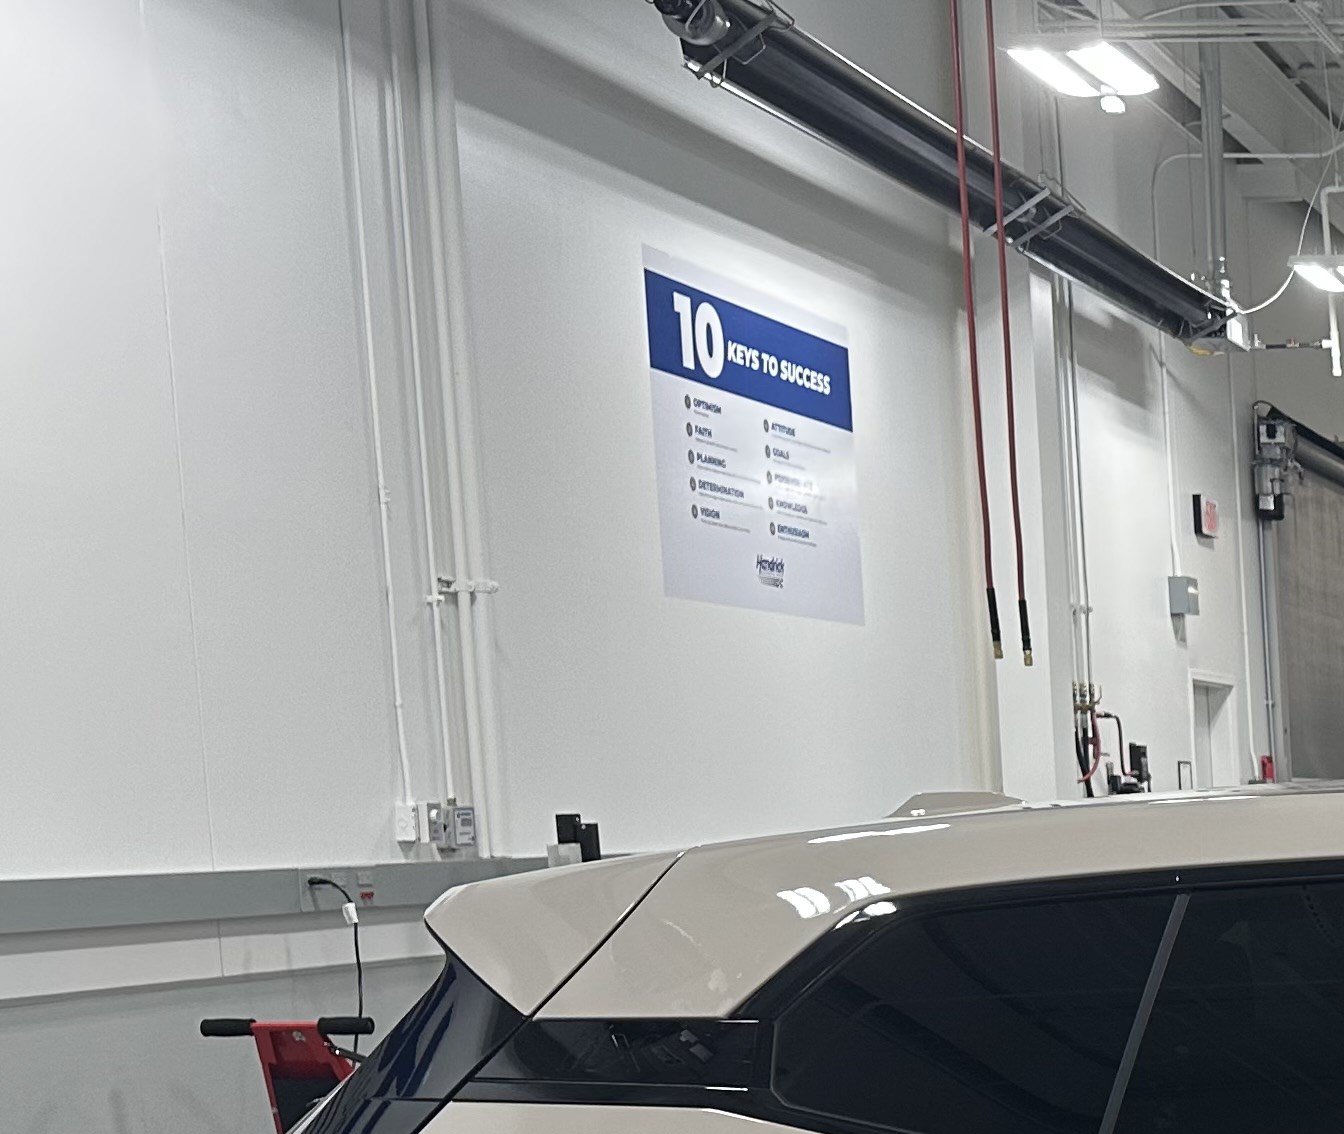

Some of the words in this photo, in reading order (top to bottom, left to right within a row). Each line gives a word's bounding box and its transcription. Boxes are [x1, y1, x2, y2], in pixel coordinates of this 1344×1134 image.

[672, 291, 725, 379] 10
[727, 340, 760, 371] KEYS
[761, 353, 778, 377] TO
[780, 359, 831, 396] SUCCESS
